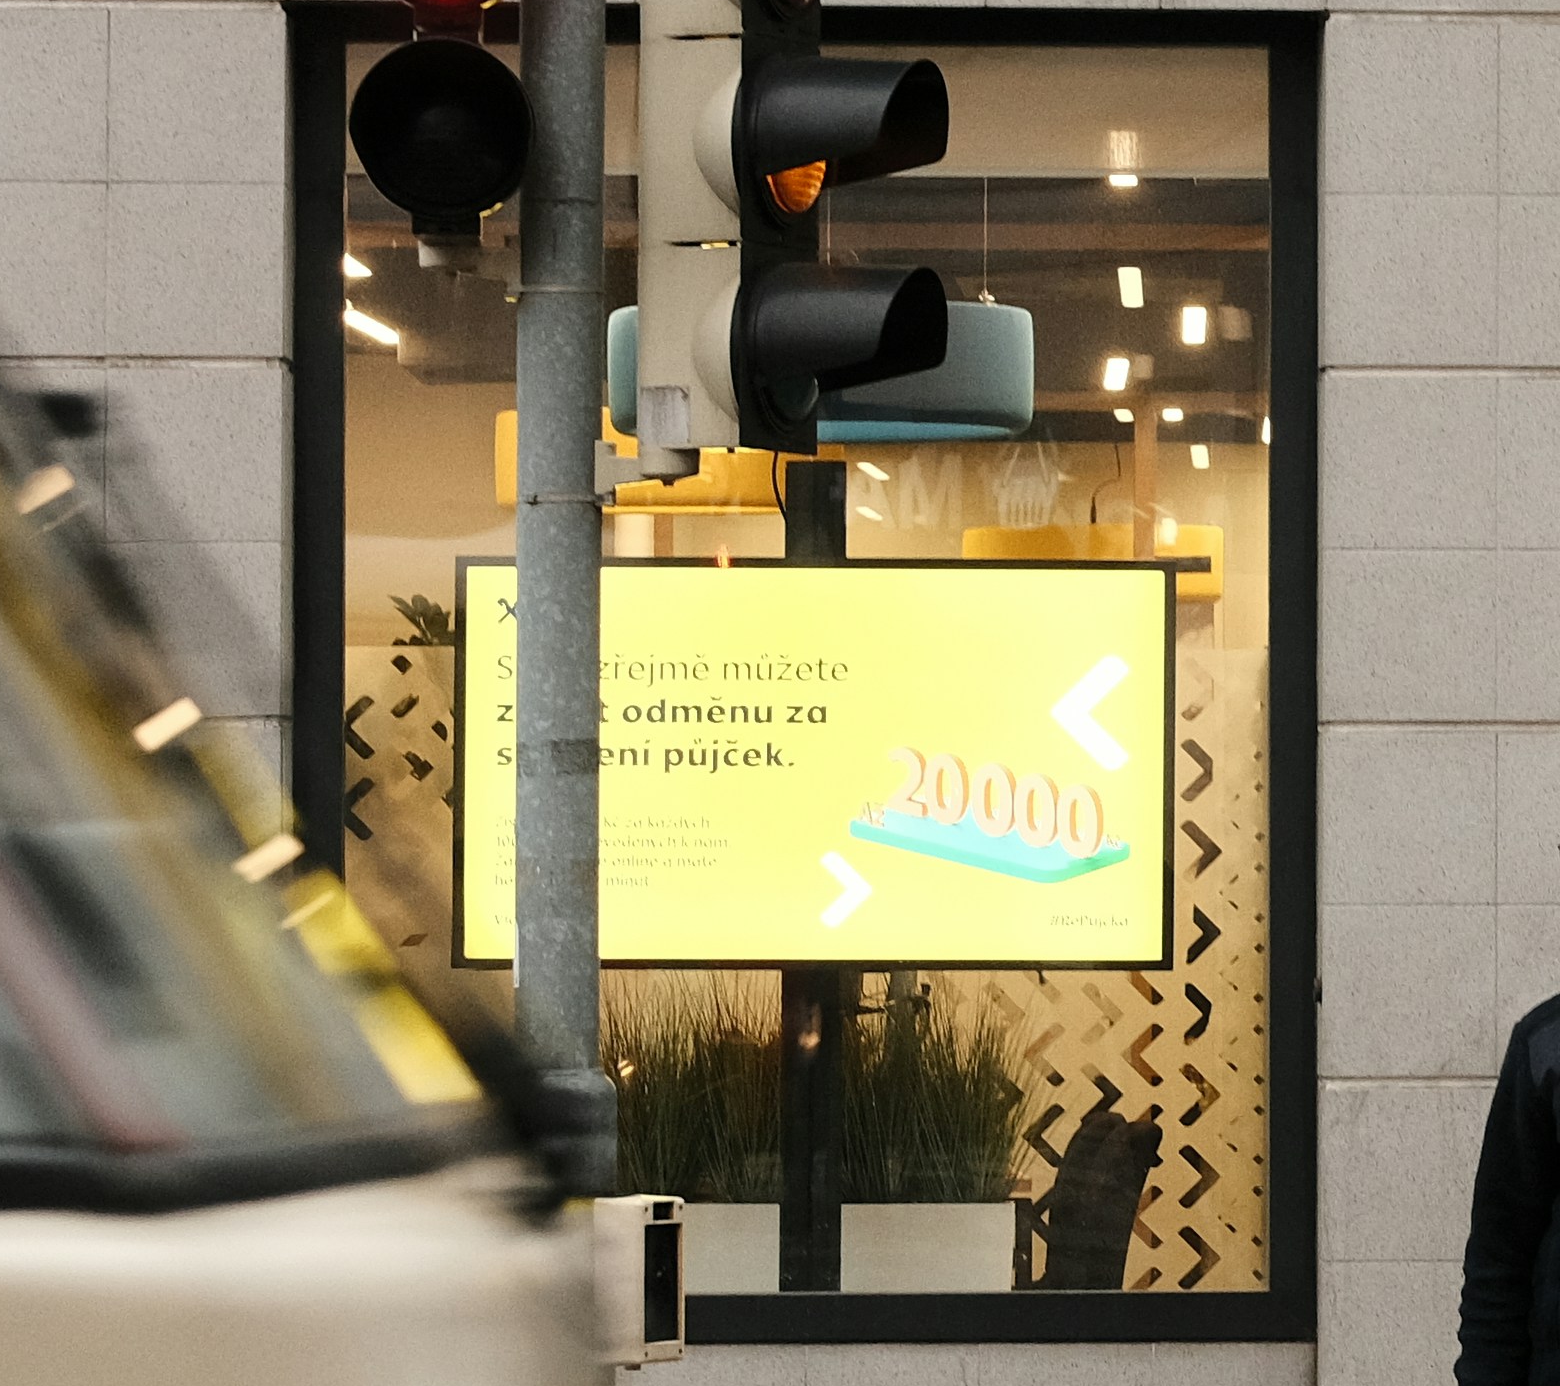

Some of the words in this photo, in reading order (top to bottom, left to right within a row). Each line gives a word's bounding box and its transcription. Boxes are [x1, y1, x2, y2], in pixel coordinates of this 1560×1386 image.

[722, 653, 850, 682] můžete
[622, 696, 773, 725] odměnu
[786, 705, 828, 724] za
[663, 738, 796, 773] půjček.
